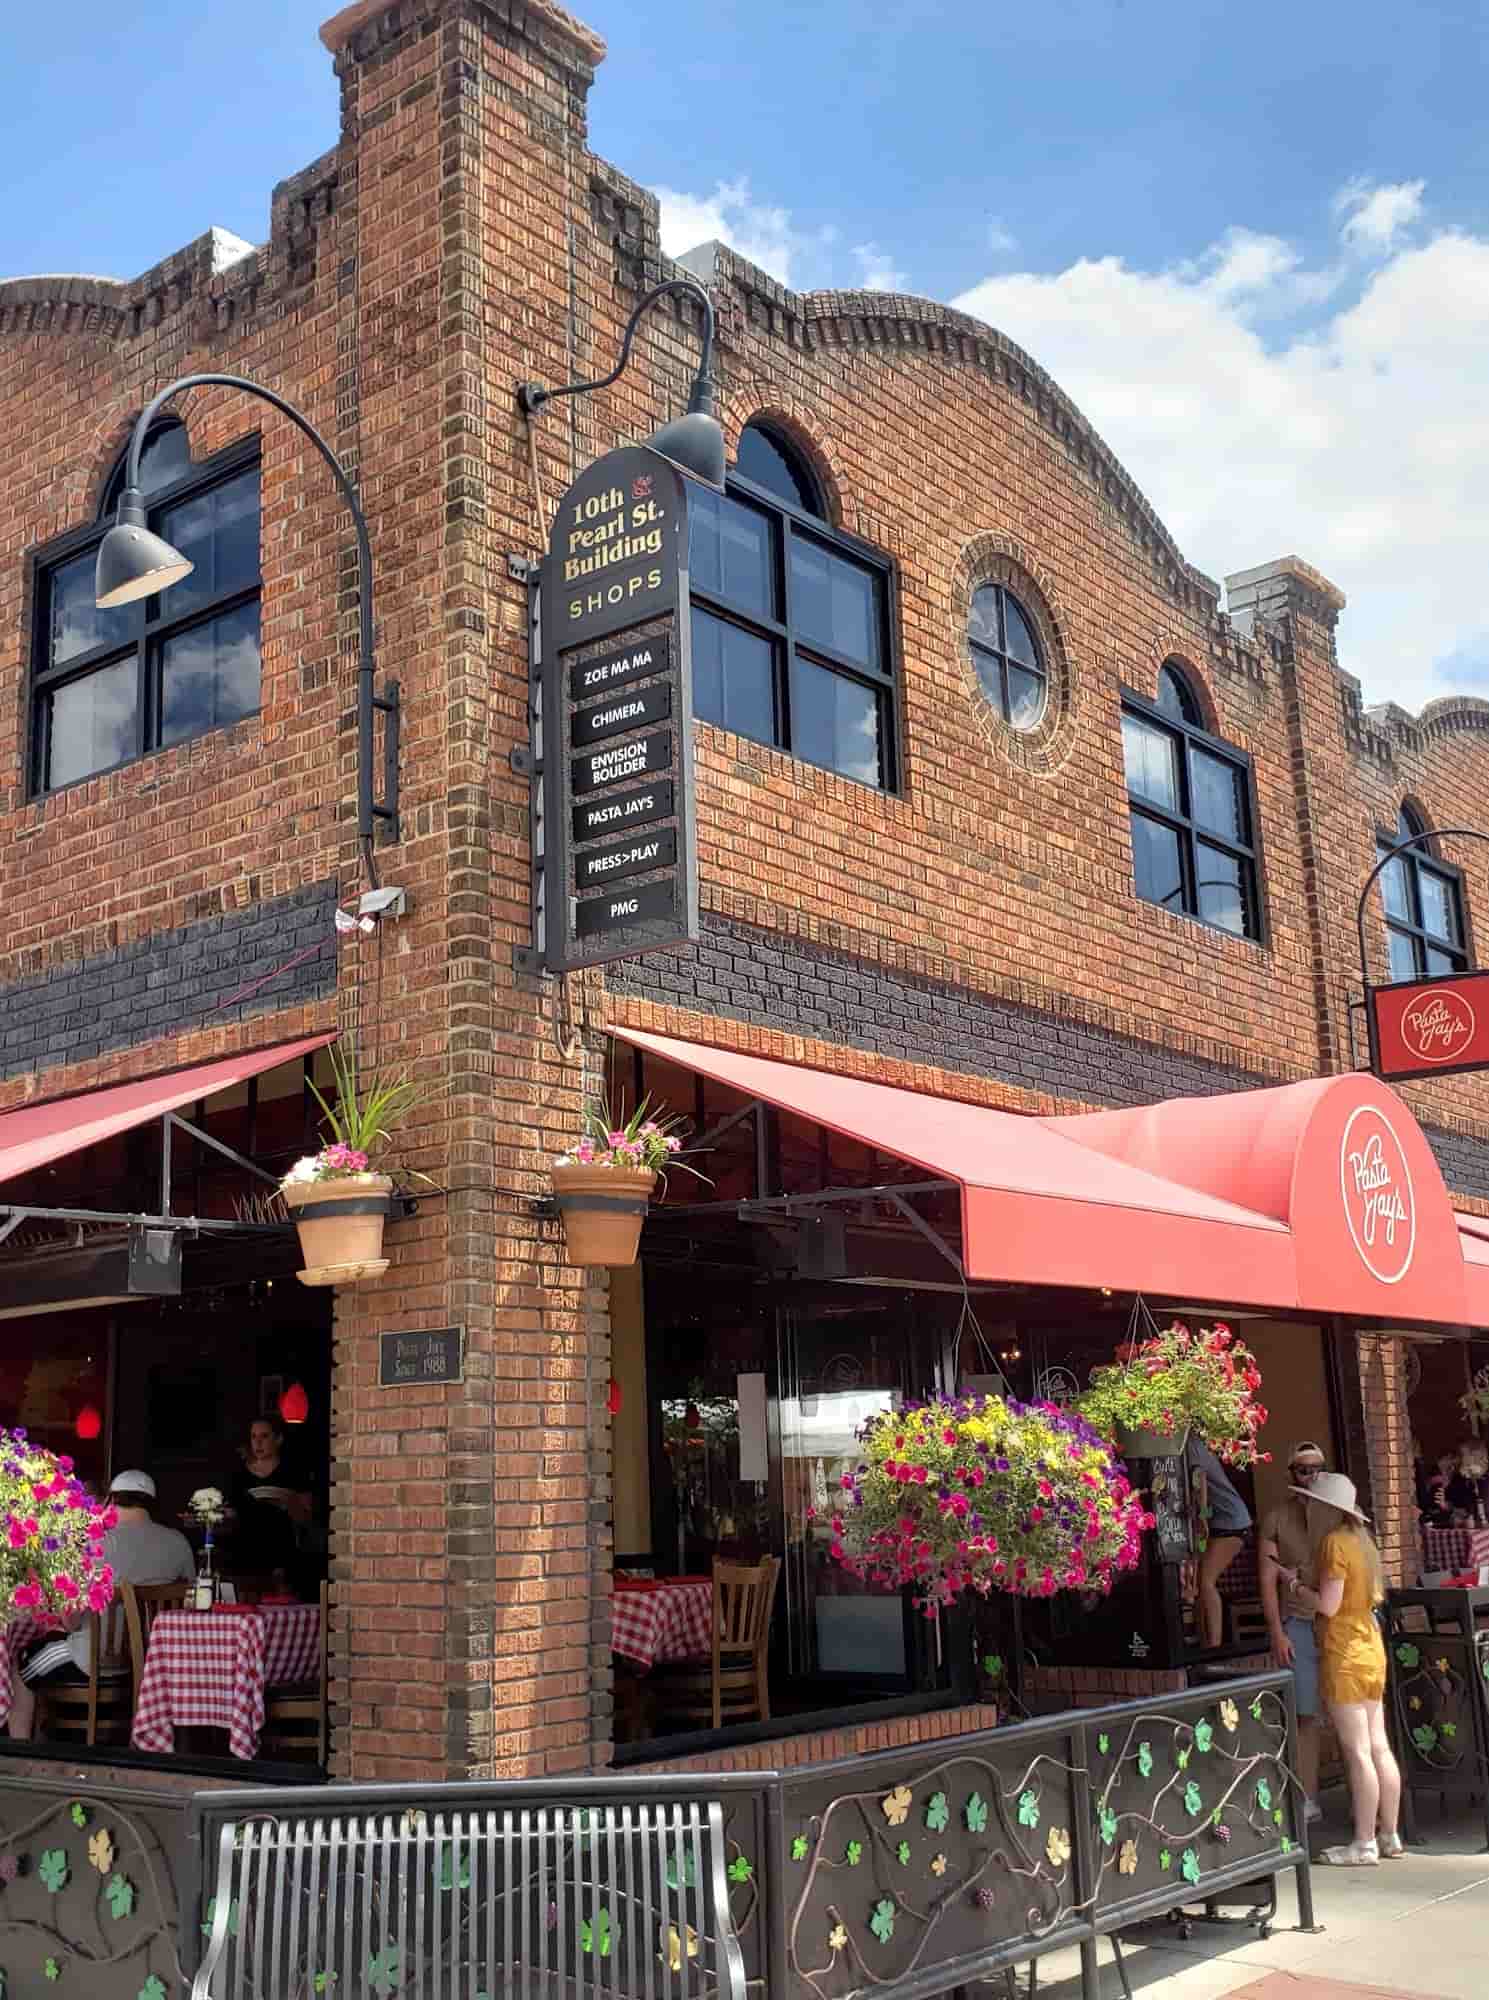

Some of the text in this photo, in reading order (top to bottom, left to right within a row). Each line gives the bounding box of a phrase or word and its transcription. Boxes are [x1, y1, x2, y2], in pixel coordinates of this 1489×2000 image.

[572, 488, 624, 525] 10th
[568, 500, 665, 553] Pearl St.
[564, 528, 663, 581] Building
[569, 569, 661, 618] SHOPS
[583, 651, 652, 685] ZOE MA MA
[591, 701, 645, 728] CHIMERA
[591, 741, 648, 770] ENVISION
[593, 757, 647, 784] BOULDER
[587, 796, 654, 825] PASTA JAY'S
[610, 900, 638, 918] PMG
[1407, 1000, 1451, 1032] Pasta
[1349, 1135, 1391, 1194] Pasta
